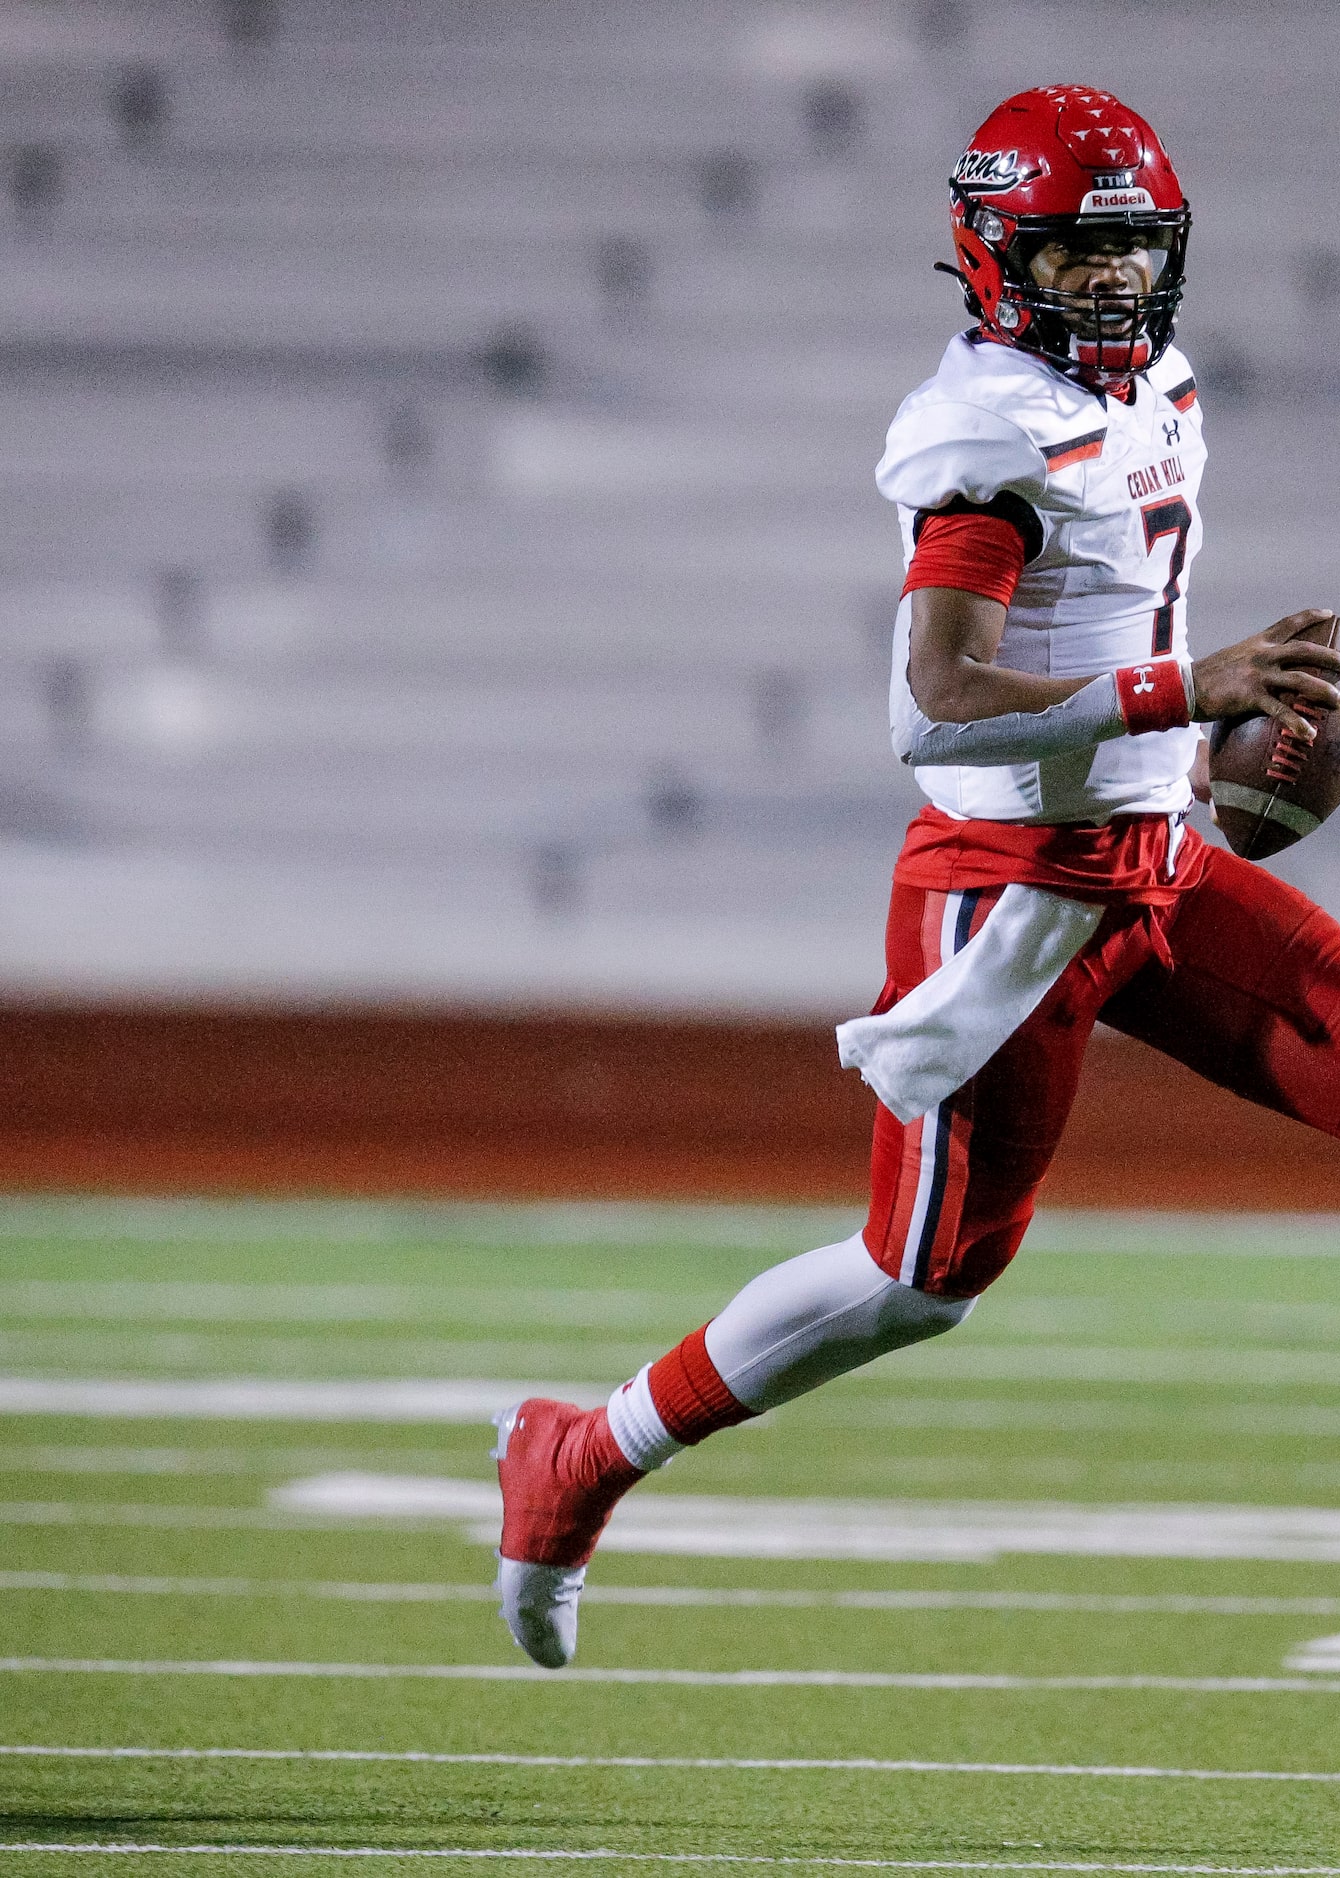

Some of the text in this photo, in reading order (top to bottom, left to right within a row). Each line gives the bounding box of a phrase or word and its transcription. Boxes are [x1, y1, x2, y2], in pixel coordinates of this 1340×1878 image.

[1092, 193, 1146, 207] Riddell
[1126, 455, 1186, 500] CEDAR HILL
[1140, 494, 1193, 658] 7
